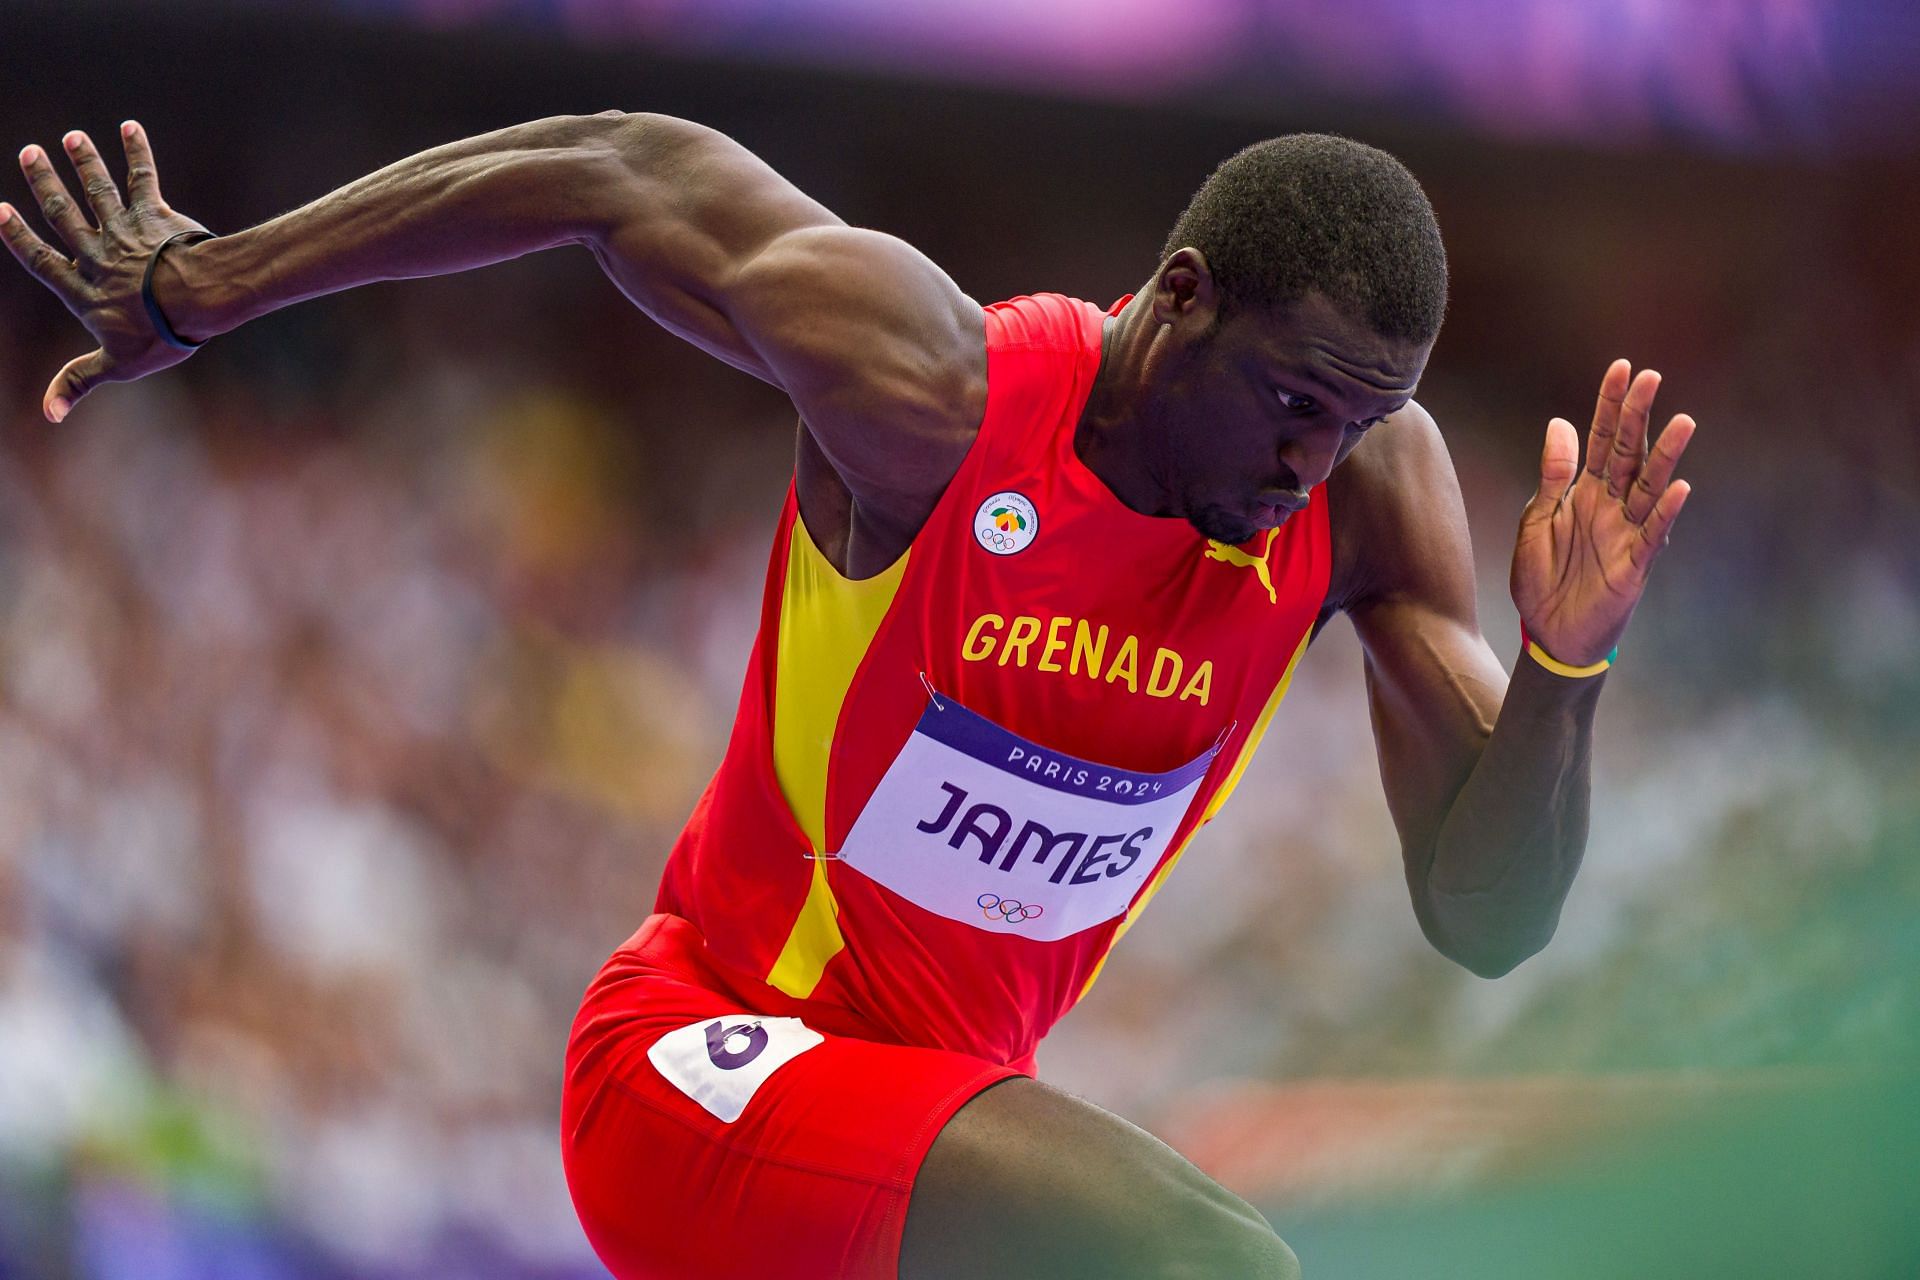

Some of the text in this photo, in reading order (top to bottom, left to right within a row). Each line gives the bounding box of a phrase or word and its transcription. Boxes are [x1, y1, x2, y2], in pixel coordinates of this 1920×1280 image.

[962, 613, 1213, 706] GRENADA
[1008, 746, 1163, 797] PARIS 2024
[916, 781, 1154, 885] JAMES
[704, 1020, 768, 1070] 6
